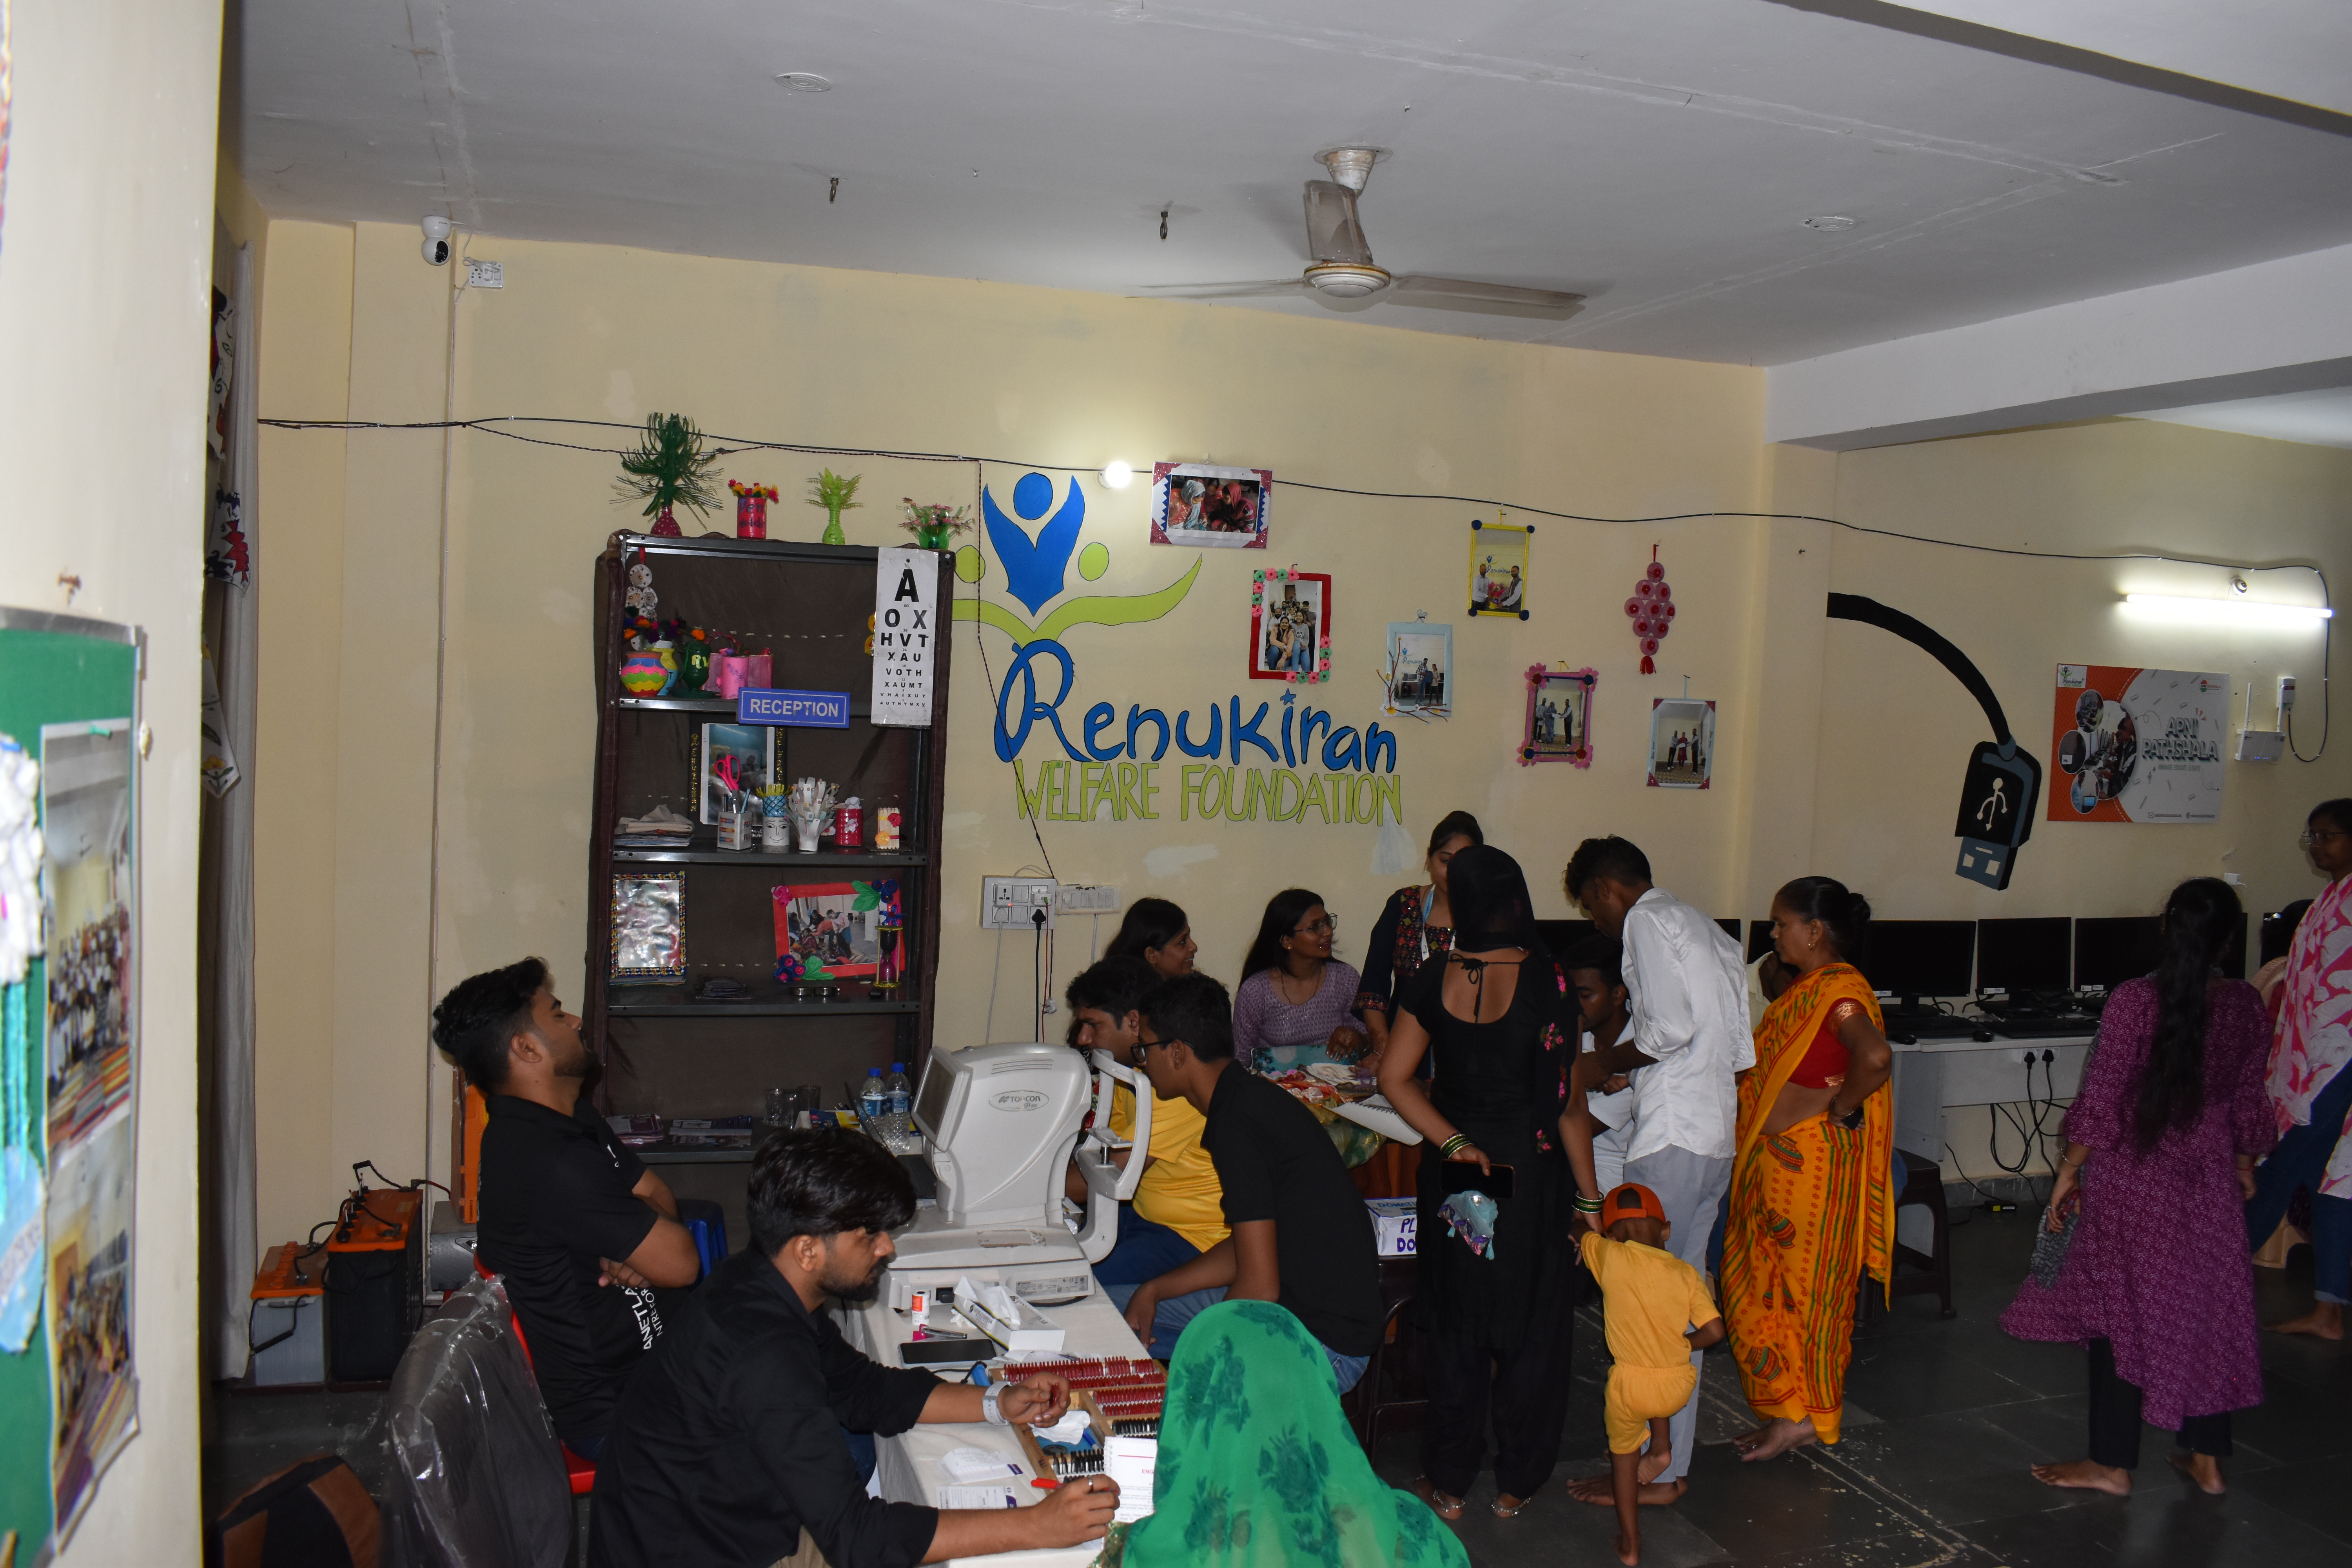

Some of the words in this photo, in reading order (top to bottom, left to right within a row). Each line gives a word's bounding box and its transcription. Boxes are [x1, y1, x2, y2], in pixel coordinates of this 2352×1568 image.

[895, 569, 919, 602] A
[750, 699, 838, 717] RECEPTION
[994, 639, 1396, 773] Renukiran
[2165, 717, 2198, 738] APNI
[2142, 739, 2219, 761] PATHSHALA
[1015, 760, 1159, 822] WELFARE
[1181, 764, 1402, 827] FOUNDATION
[1401, 1218, 1416, 1233] PL
[1397, 1238, 1416, 1252] DO
